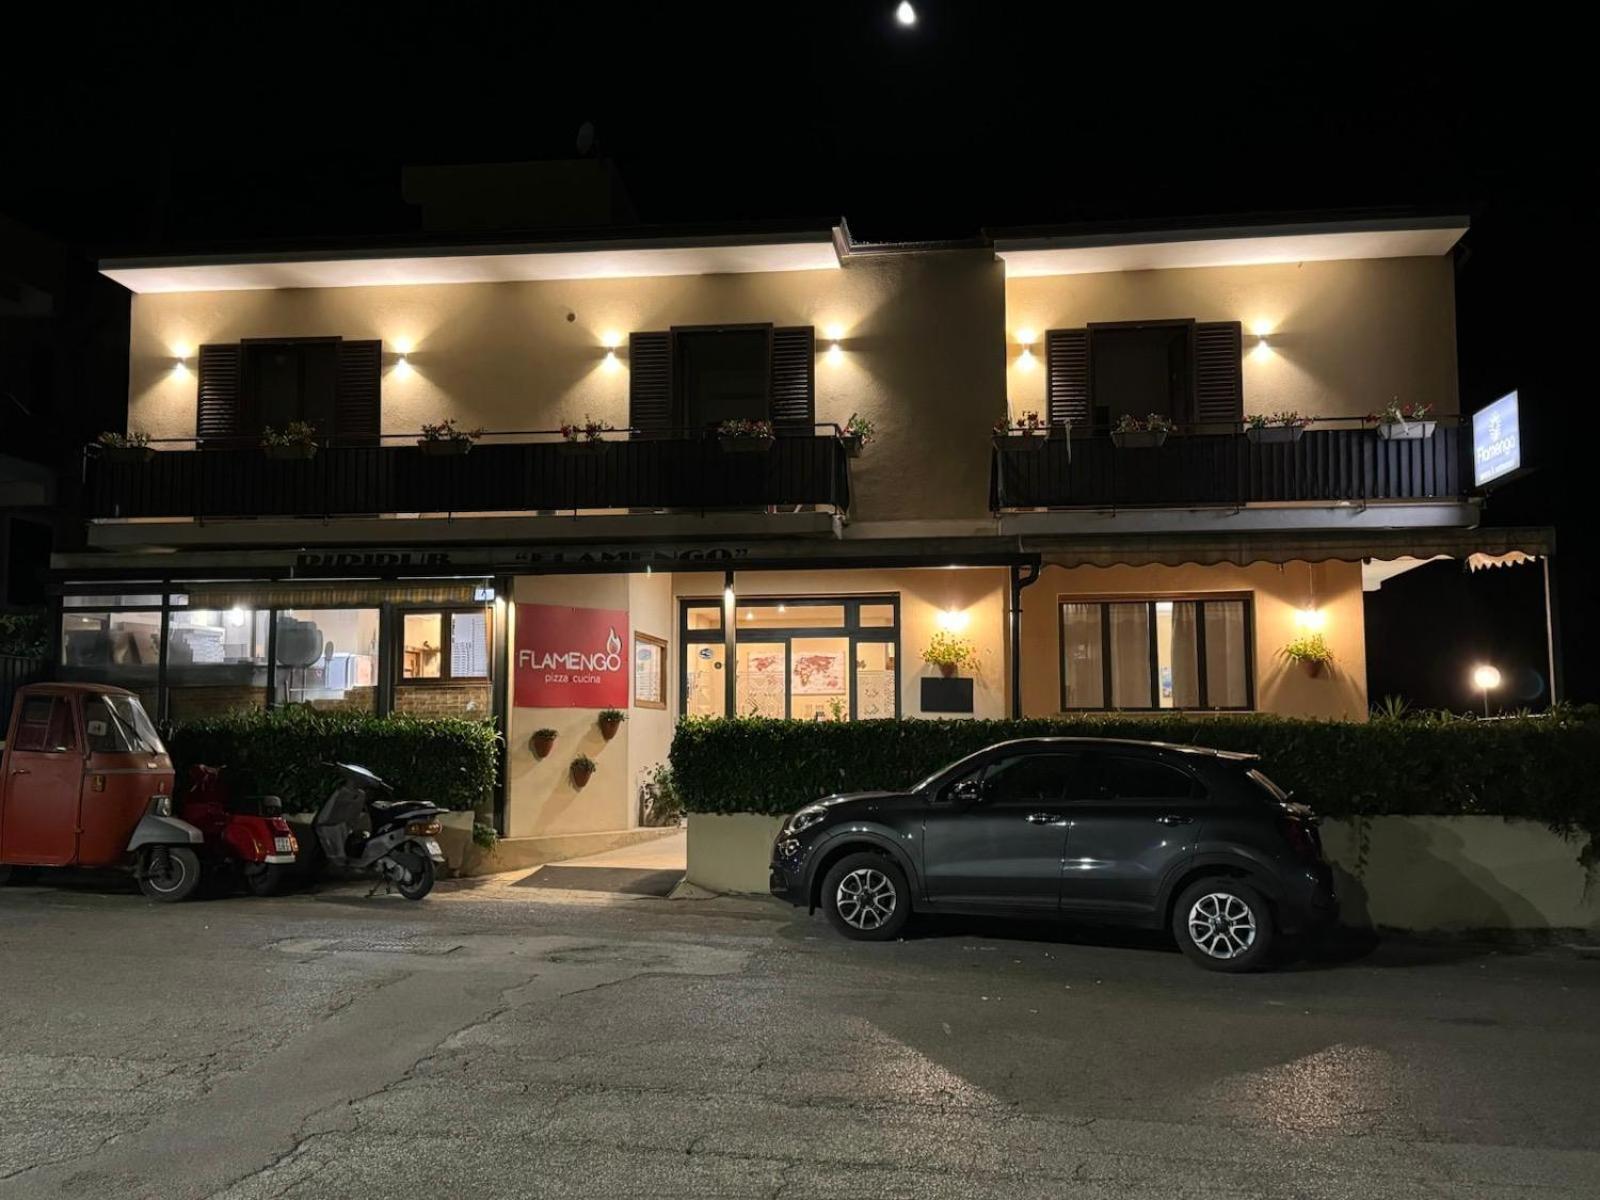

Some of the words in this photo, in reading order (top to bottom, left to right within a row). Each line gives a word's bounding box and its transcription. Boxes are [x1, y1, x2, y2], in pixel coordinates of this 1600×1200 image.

[520, 650, 622, 671] FLAMENGO
[545, 673, 569, 683] pizza
[572, 673, 601, 684] cucina
